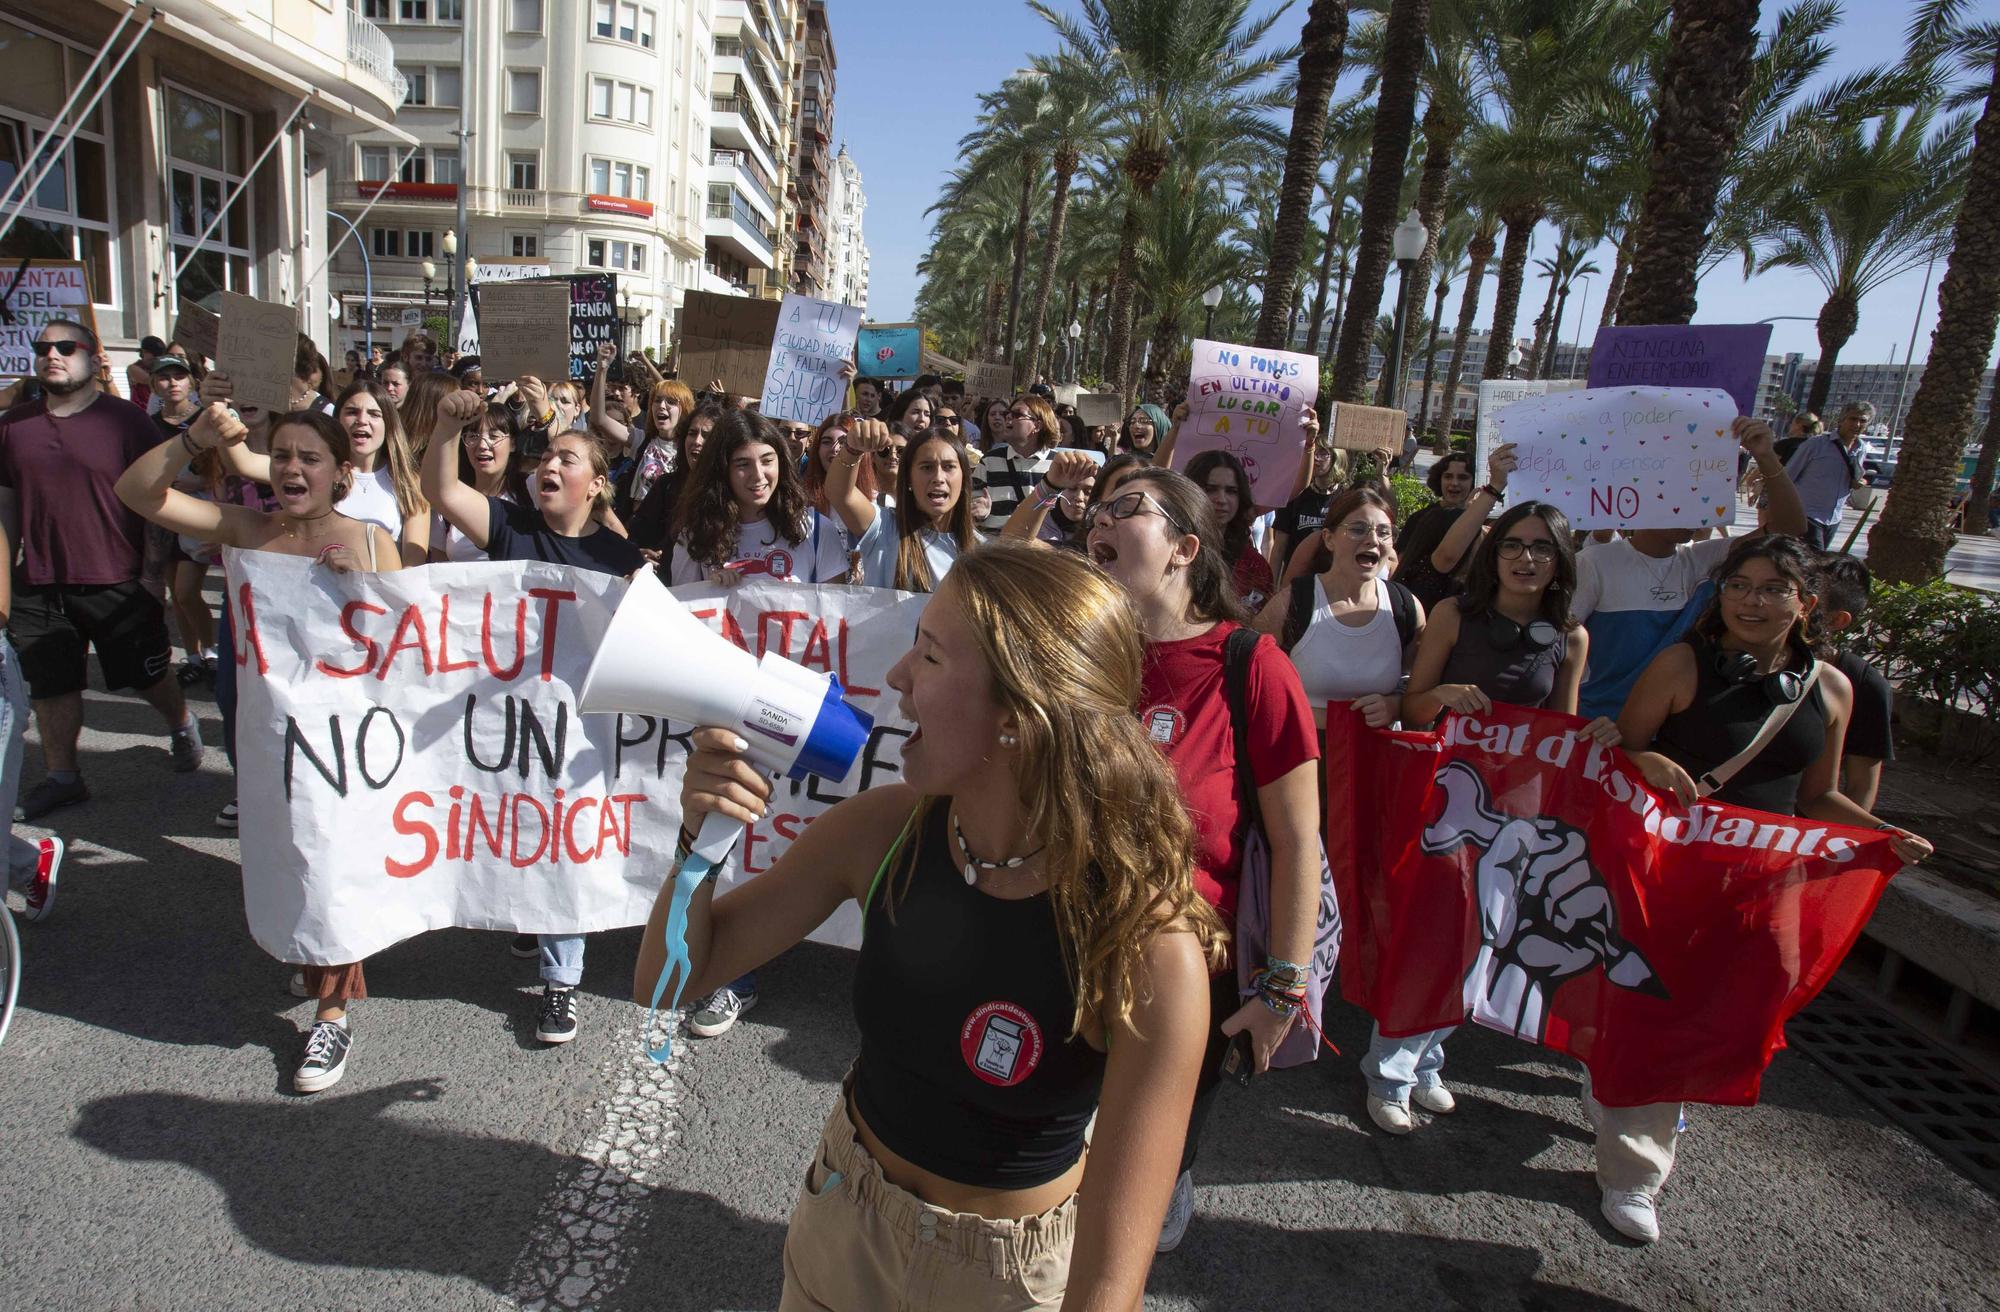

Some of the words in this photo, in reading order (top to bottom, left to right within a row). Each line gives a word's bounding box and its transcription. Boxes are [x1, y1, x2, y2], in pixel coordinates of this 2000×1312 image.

[18, 291, 58, 308] DEL
[789, 305, 801, 324] A
[815, 302, 844, 335] TU
[775, 351, 789, 367] LE
[794, 354, 827, 373] FALTA
[1218, 350, 1240, 367] NO
[1610, 338, 1706, 360] NINGUNA
[768, 367, 838, 406] SALUD
[1199, 379, 1223, 396] EN
[1216, 394, 1282, 417] LUGAR
[1214, 415, 1231, 434] A
[1245, 417, 1270, 436] TU
[1622, 405, 1684, 434] poder
[1518, 445, 1568, 484] deja
[1583, 448, 1602, 472] de
[1610, 456, 1674, 478] pensar
[1688, 458, 1730, 481] que
[1589, 486, 1640, 521] NO
[316, 587, 578, 683] SALUT
[283, 706, 406, 803] NO
[464, 693, 568, 780] UN
